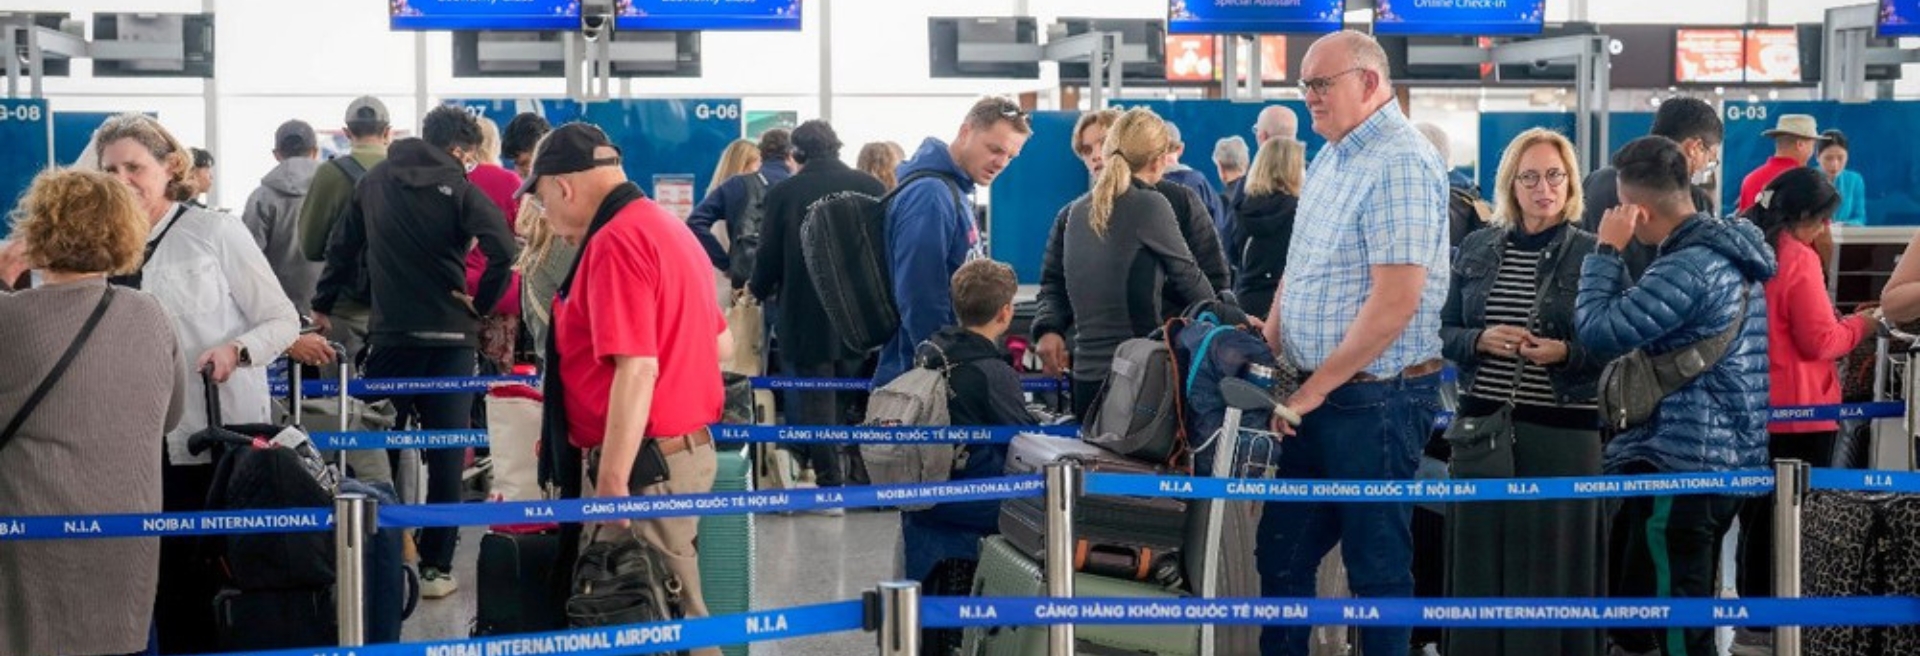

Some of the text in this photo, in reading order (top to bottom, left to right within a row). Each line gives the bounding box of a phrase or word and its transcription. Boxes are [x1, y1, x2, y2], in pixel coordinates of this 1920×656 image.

[1414, 0, 1453, 8] Online
[695, 103, 739, 120] G-06
[1727, 105, 1767, 120] G-03
[1771, 407, 1815, 419] AIRPORT
[329, 433, 488, 447] N.I.A NOIBAI INTERNATI
[1159, 480, 1193, 493] N.I.A
[1507, 481, 1540, 494] N.I.A
[1574, 480, 1619, 494] NOIBAI
[1622, 477, 1727, 492] INTERNATIONAL
[1730, 475, 1775, 488] AIRPO
[1864, 474, 1893, 487] N.I.A
[525, 506, 554, 517] N.I.A
[815, 493, 843, 504] N.I.A
[877, 488, 918, 500] NOIBAI
[920, 483, 1013, 498] INTERNATIONAL
[64, 519, 102, 534] N.I.A
[143, 516, 195, 532] NOIBAI
[201, 514, 318, 530] INTERNATIONAL
[959, 604, 997, 619] N.I.A
[1127, 602, 1182, 619] KHÔNG
[1343, 605, 1379, 619] N.I.A
[1423, 606, 1477, 620] NOIBAI
[1479, 605, 1600, 620] INTERNATIONAL
[1603, 606, 1671, 620] AIRPORT
[1713, 605, 1749, 619] N.I.A
[426, 613, 788, 656] NOIBAI INTERNATIONAL AIRPORT N.I.A
